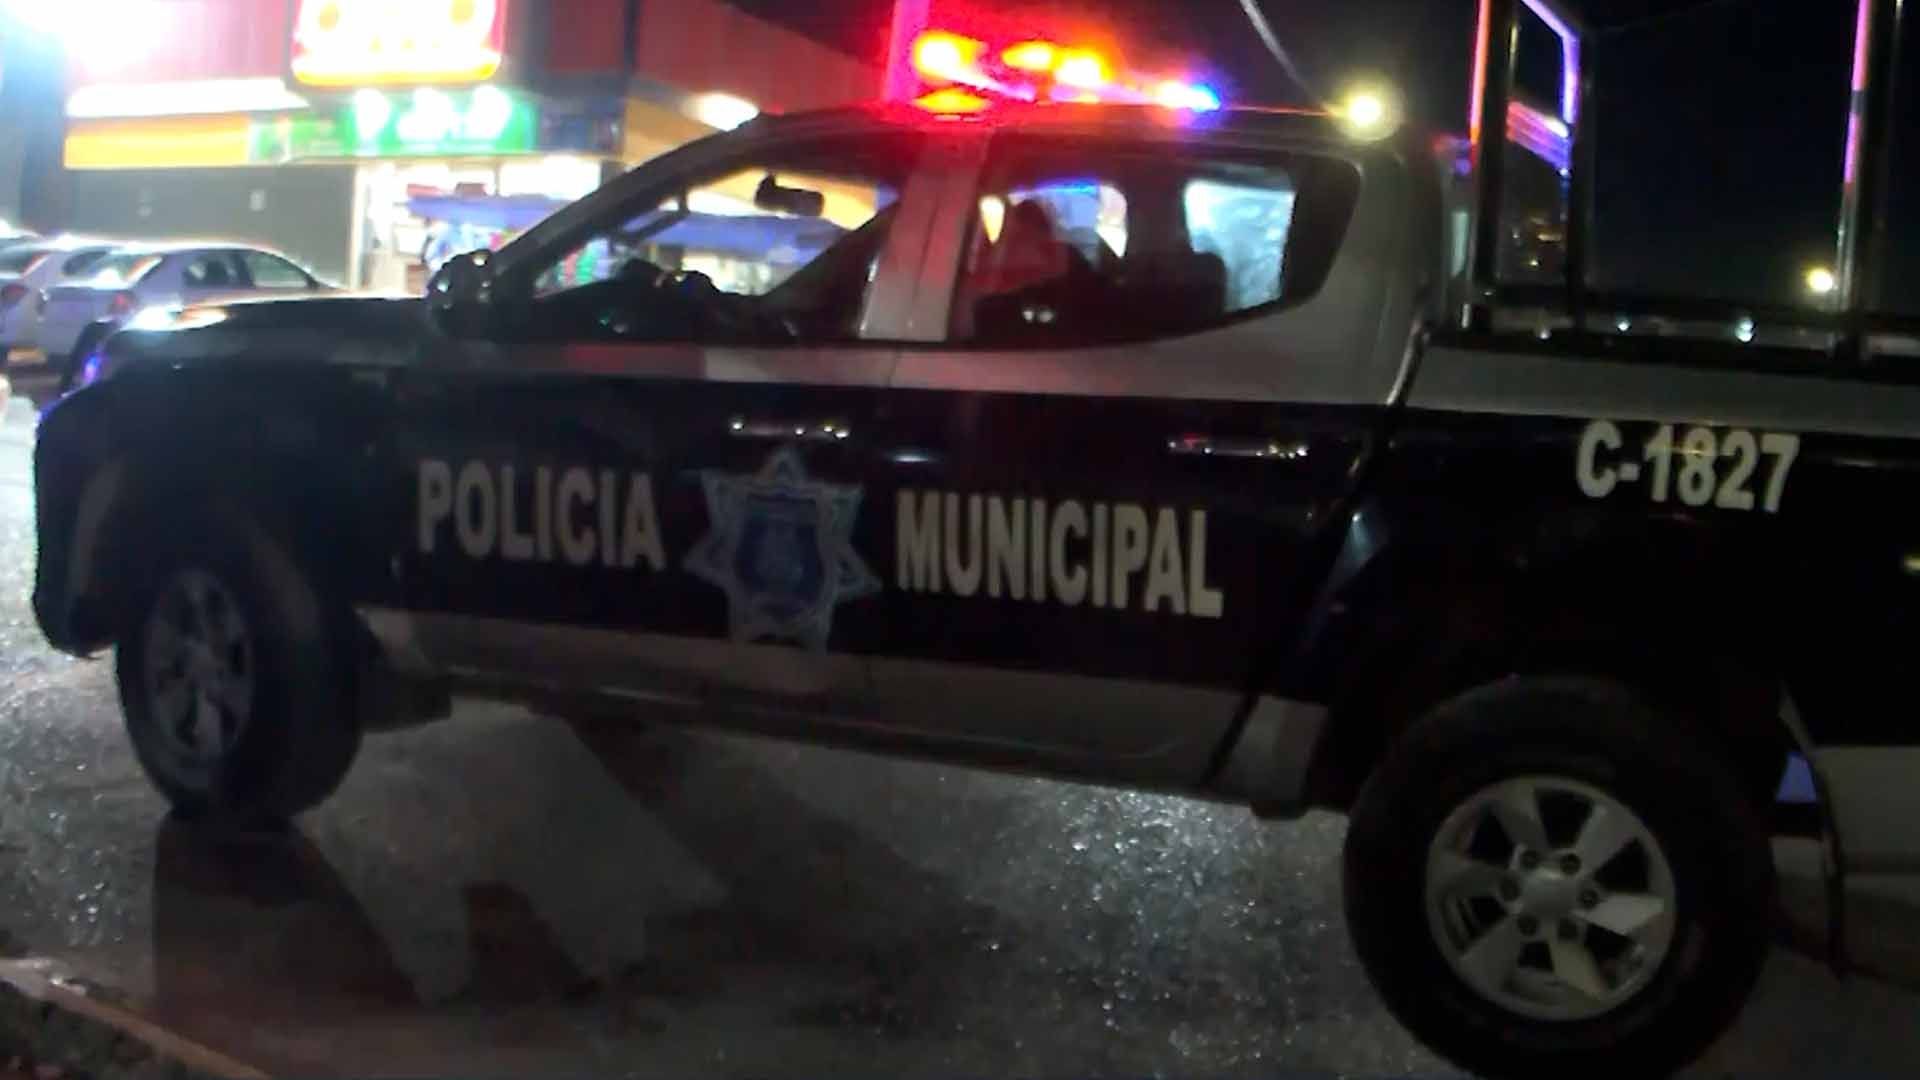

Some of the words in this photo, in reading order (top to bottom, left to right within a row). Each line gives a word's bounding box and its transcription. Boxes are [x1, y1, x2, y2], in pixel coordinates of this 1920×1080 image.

[1576, 420, 1800, 513] C-1827
[418, 459, 665, 571] POLICIA
[897, 487, 1224, 618] MUNICIPAL
